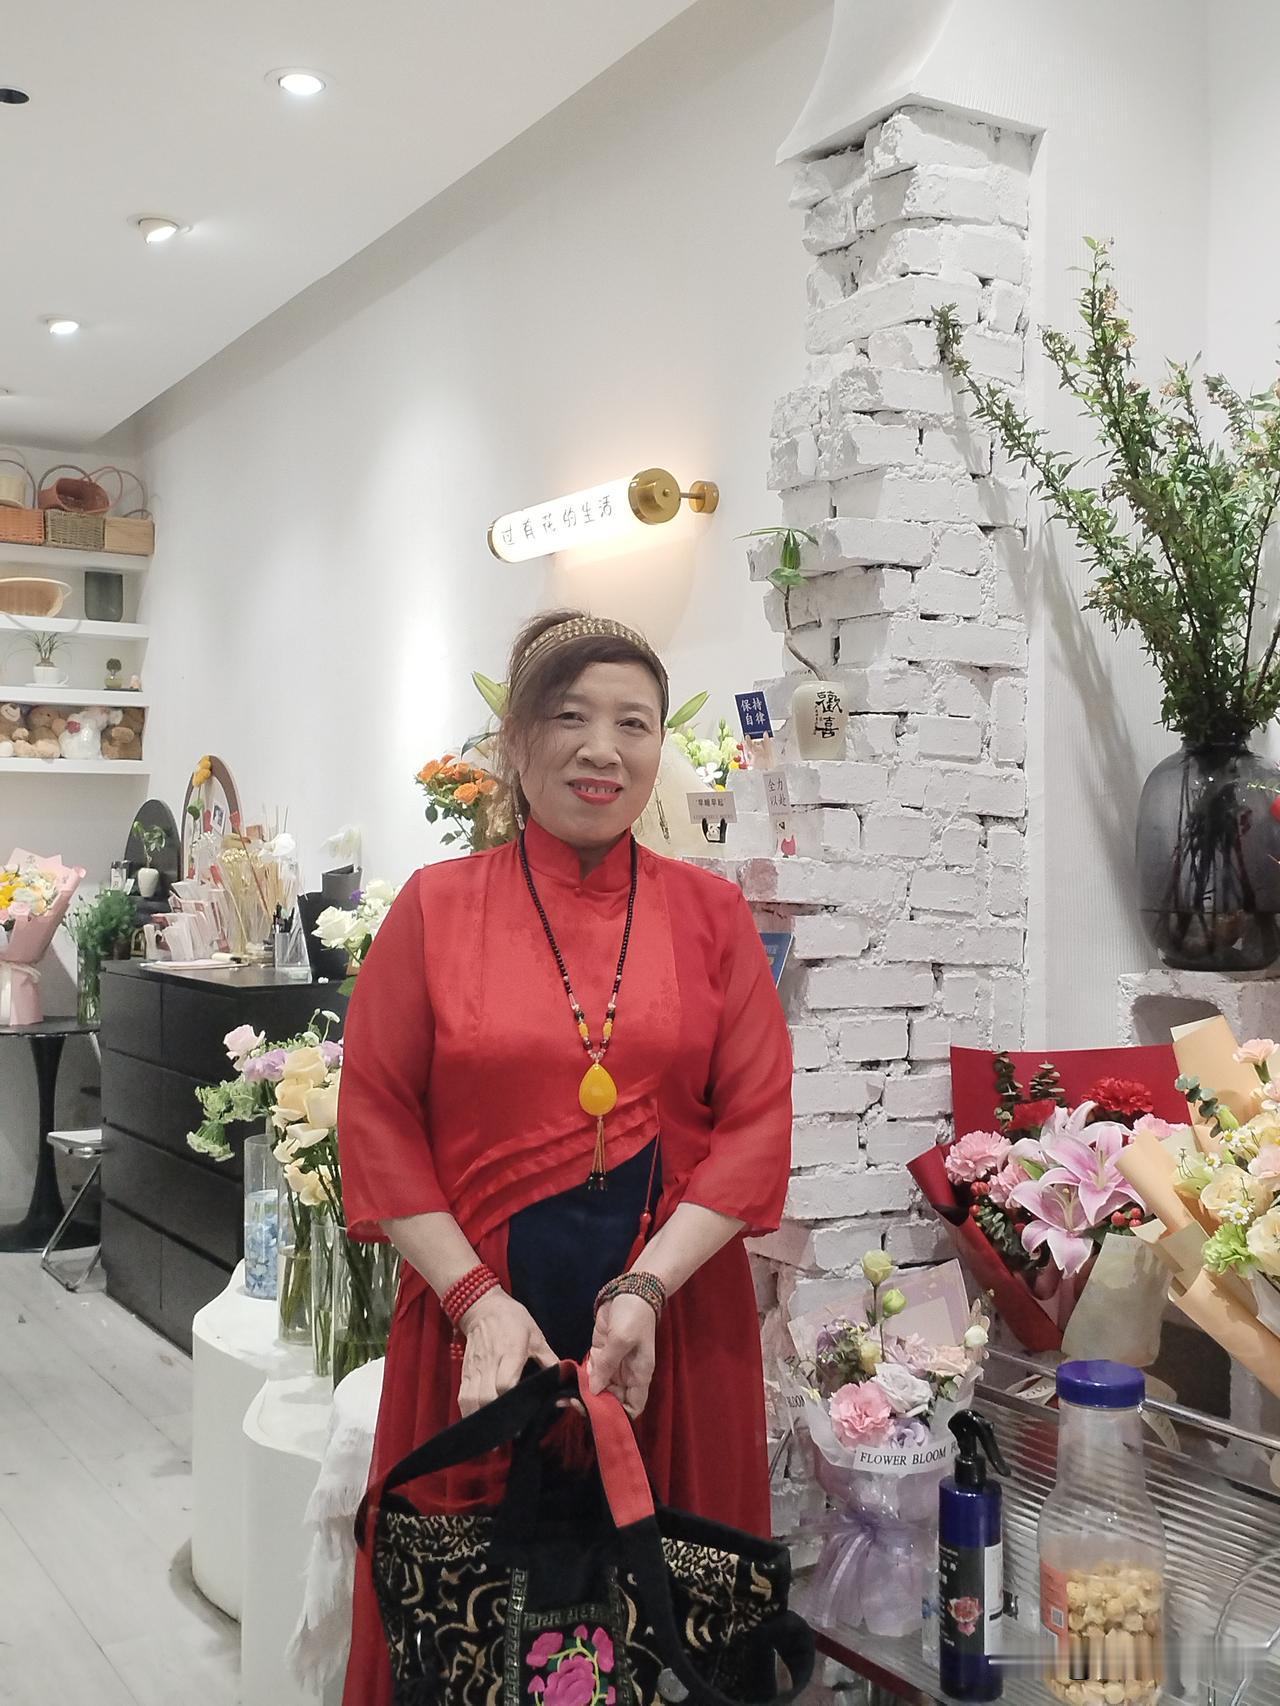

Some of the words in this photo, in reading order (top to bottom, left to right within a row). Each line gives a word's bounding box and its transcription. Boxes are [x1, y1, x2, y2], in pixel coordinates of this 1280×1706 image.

[740, 697, 763, 712] 保持
[745, 711, 766, 726] 自律
[860, 1452, 907, 1466] FLOWER
[912, 1446, 947, 1465] BLOOM
